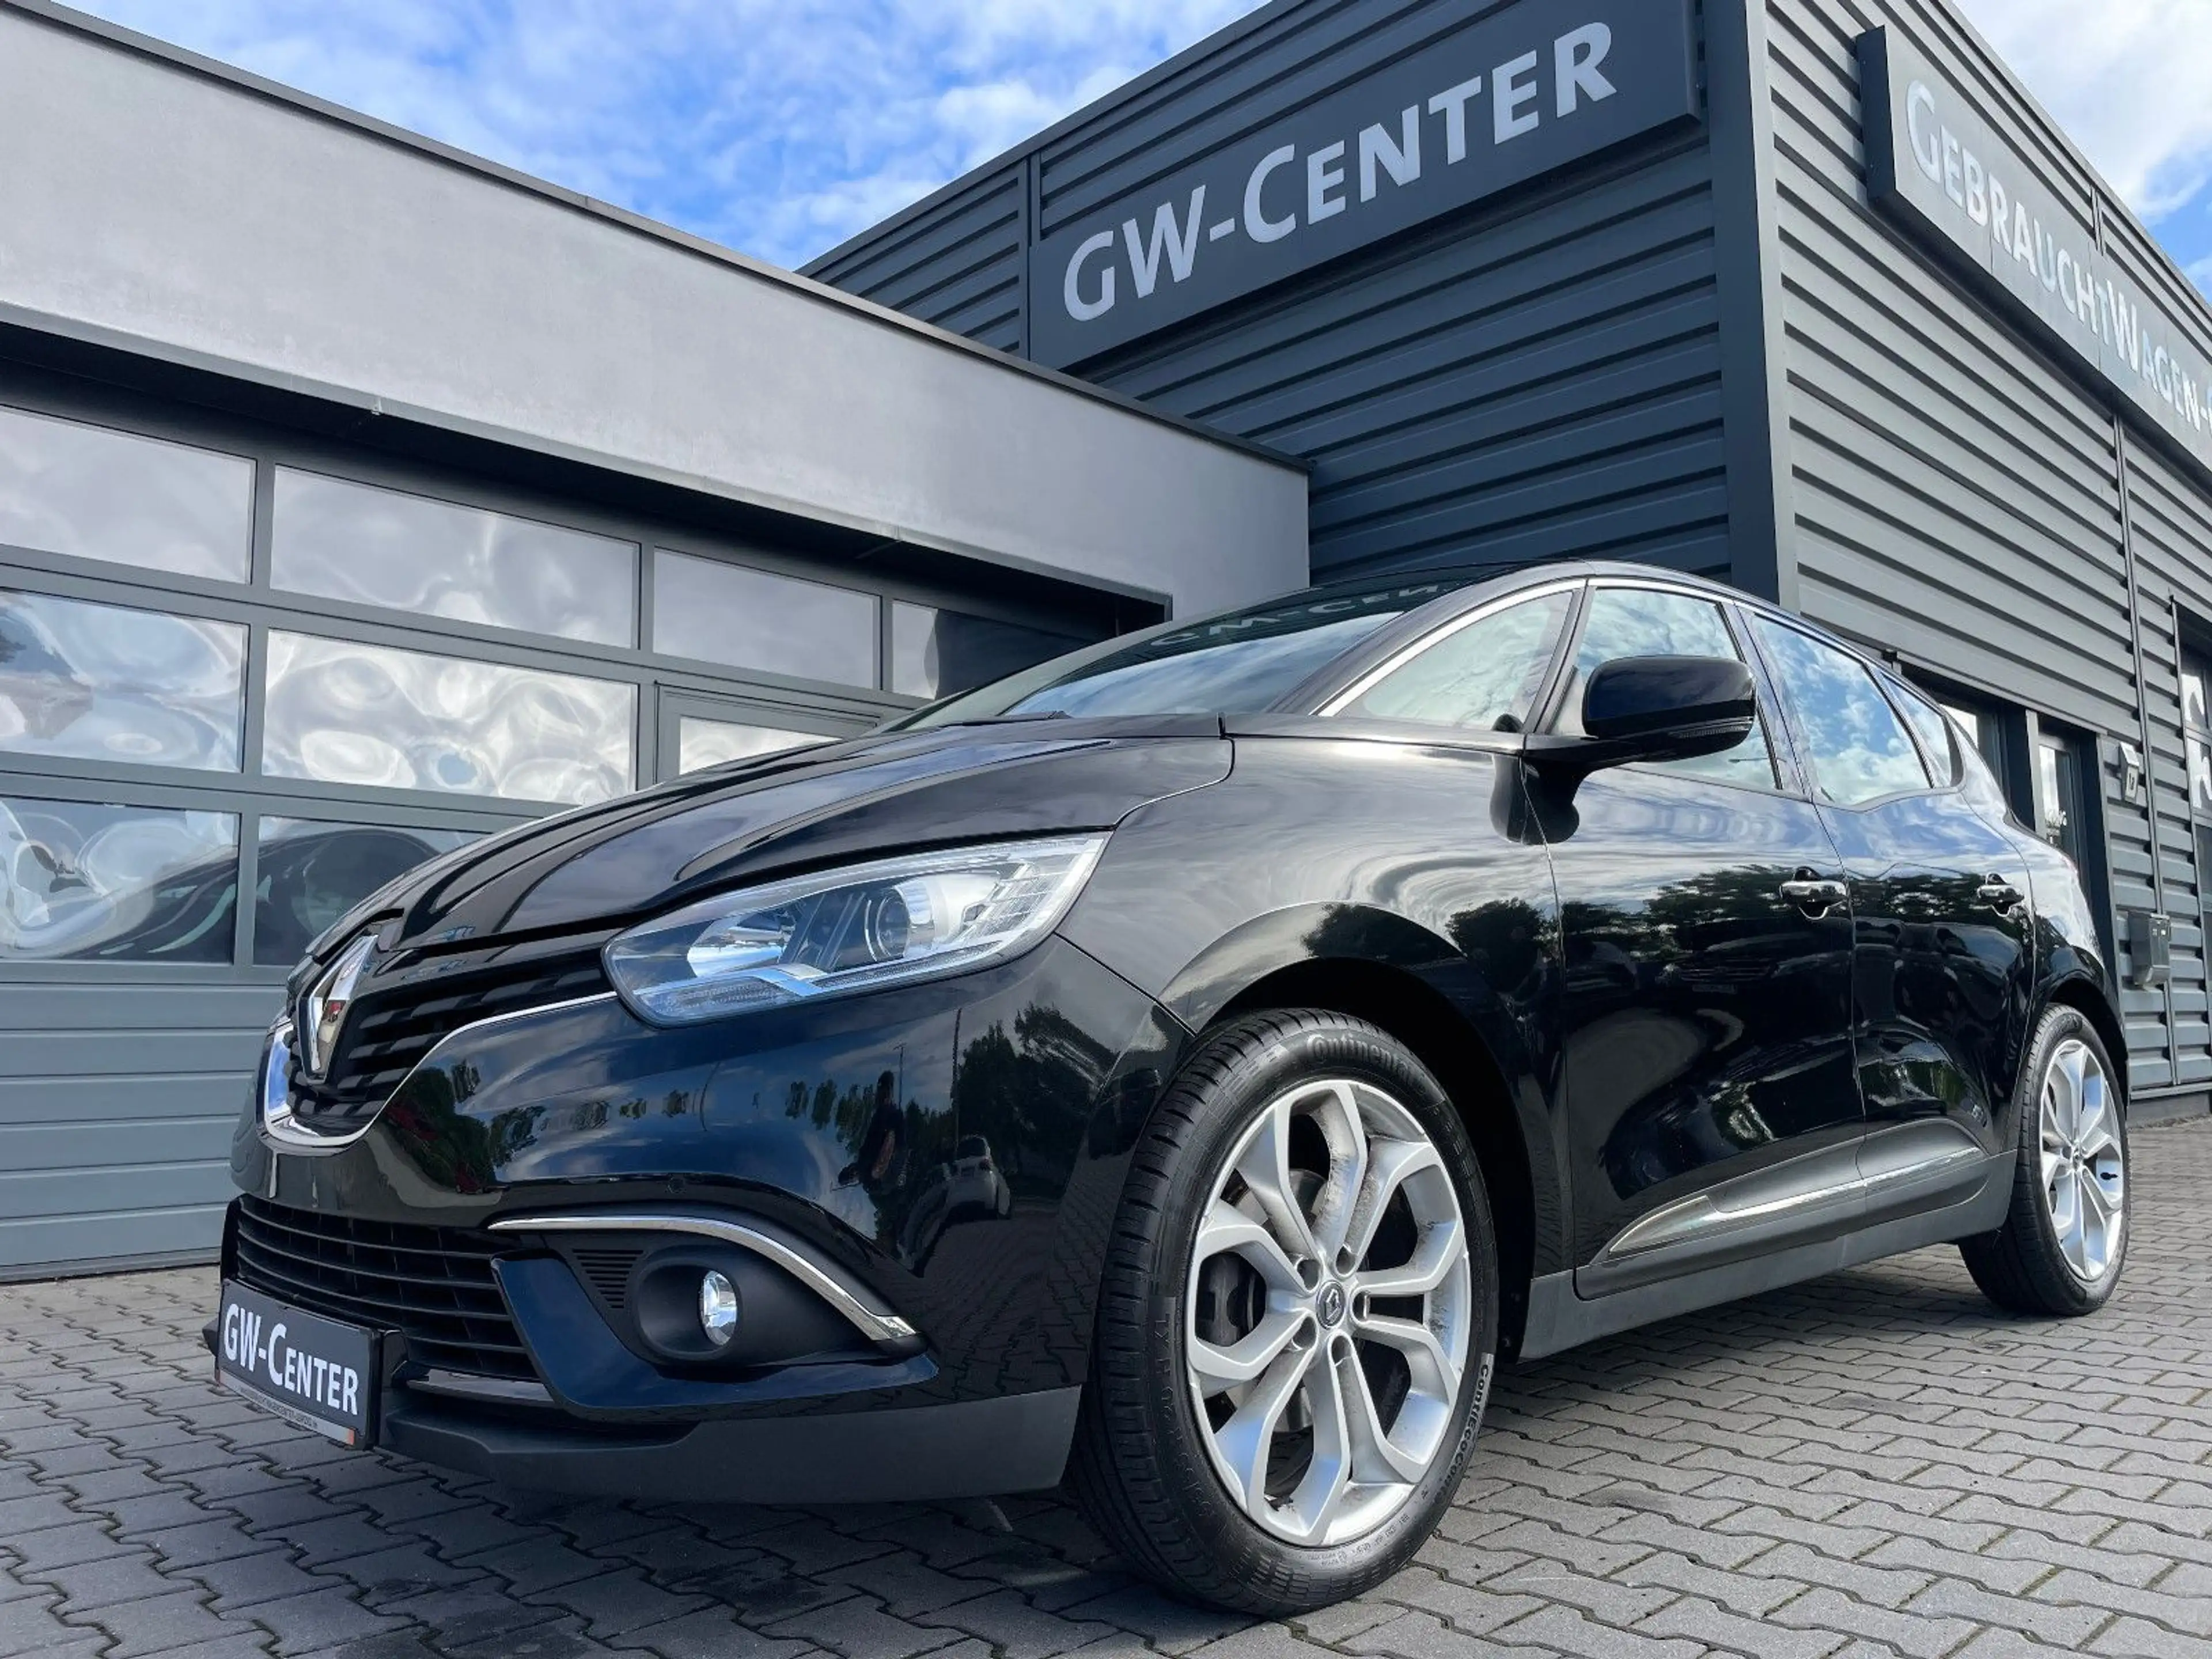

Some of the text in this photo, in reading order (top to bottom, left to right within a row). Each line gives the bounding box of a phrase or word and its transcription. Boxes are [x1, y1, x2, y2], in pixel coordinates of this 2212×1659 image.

[1063, 21, 1617, 322] GW-CENTER
[1906, 79, 2212, 436] GEBRAUCHTWAGEN-
[224, 1303, 358, 1415] GW-CENTER
